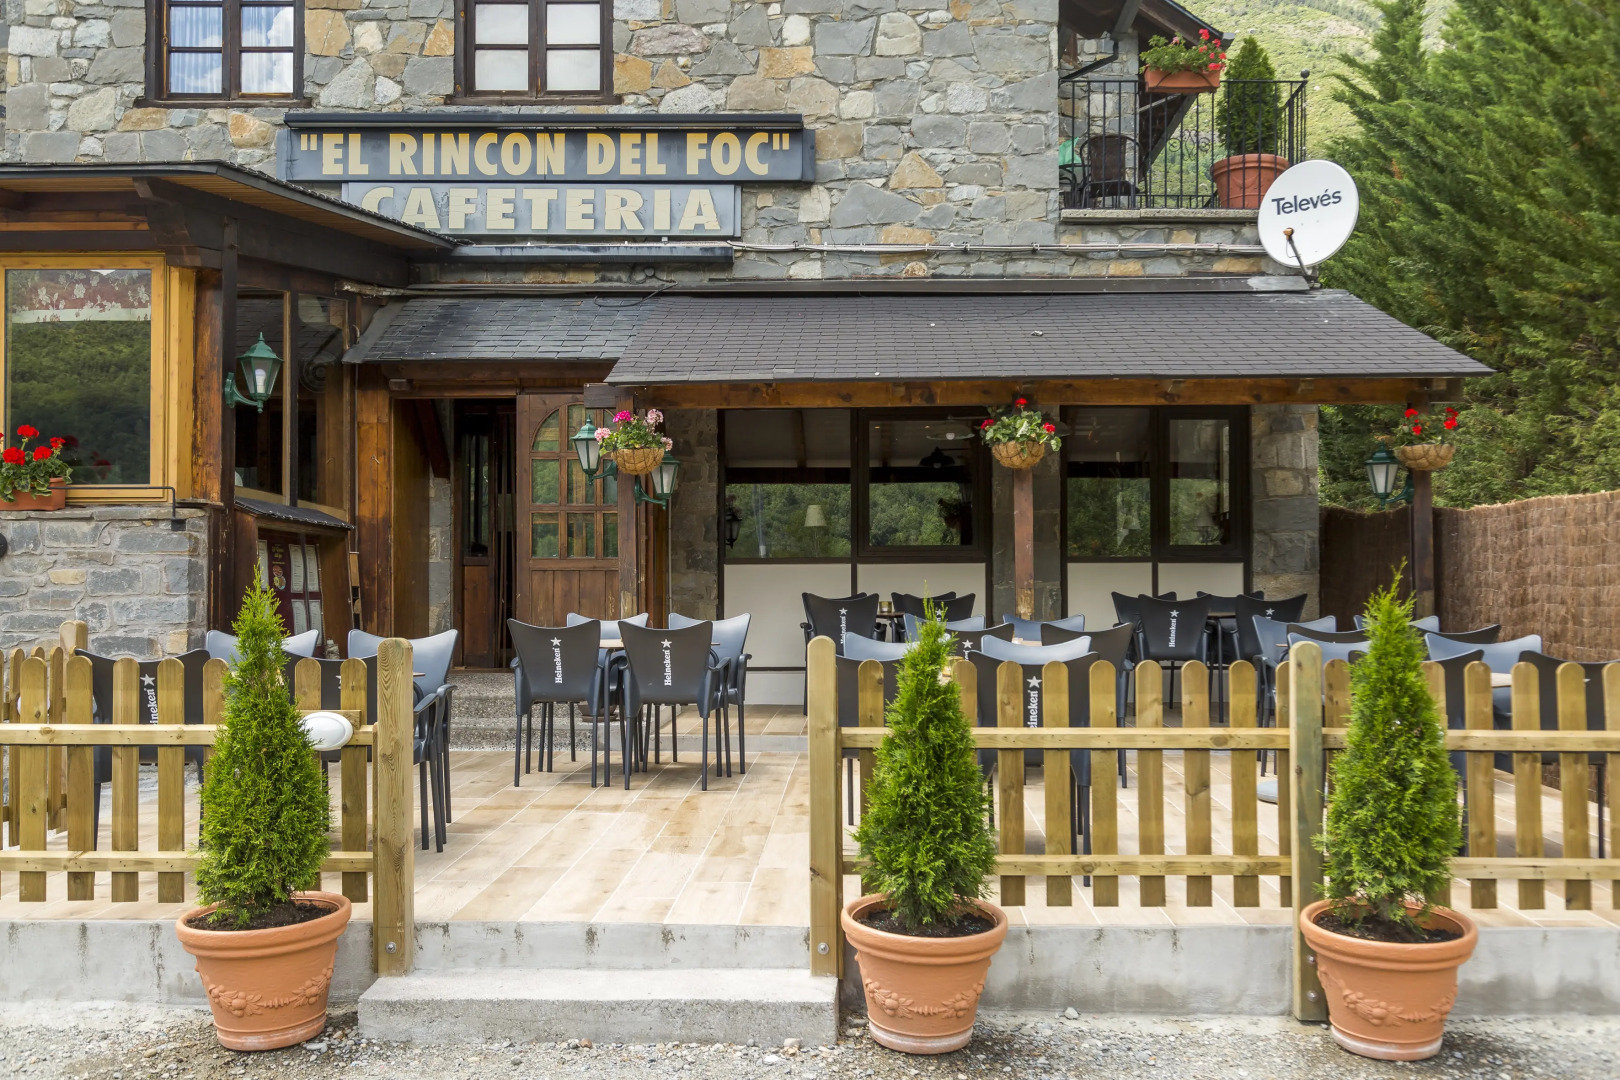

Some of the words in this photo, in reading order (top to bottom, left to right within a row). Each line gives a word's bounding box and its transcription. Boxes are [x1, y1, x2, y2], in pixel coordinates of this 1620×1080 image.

[300, 133, 369, 175] "EL
[388, 132, 566, 176] RINCON
[586, 132, 667, 176] DEL
[686, 131, 790, 176] FOC"
[361, 186, 721, 231] CAFETERIA
[1271, 189, 1342, 216] Televés
[1168, 618, 1177, 648] Heineken
[553, 647, 563, 684] Heineken
[663, 649, 672, 686] Heineken
